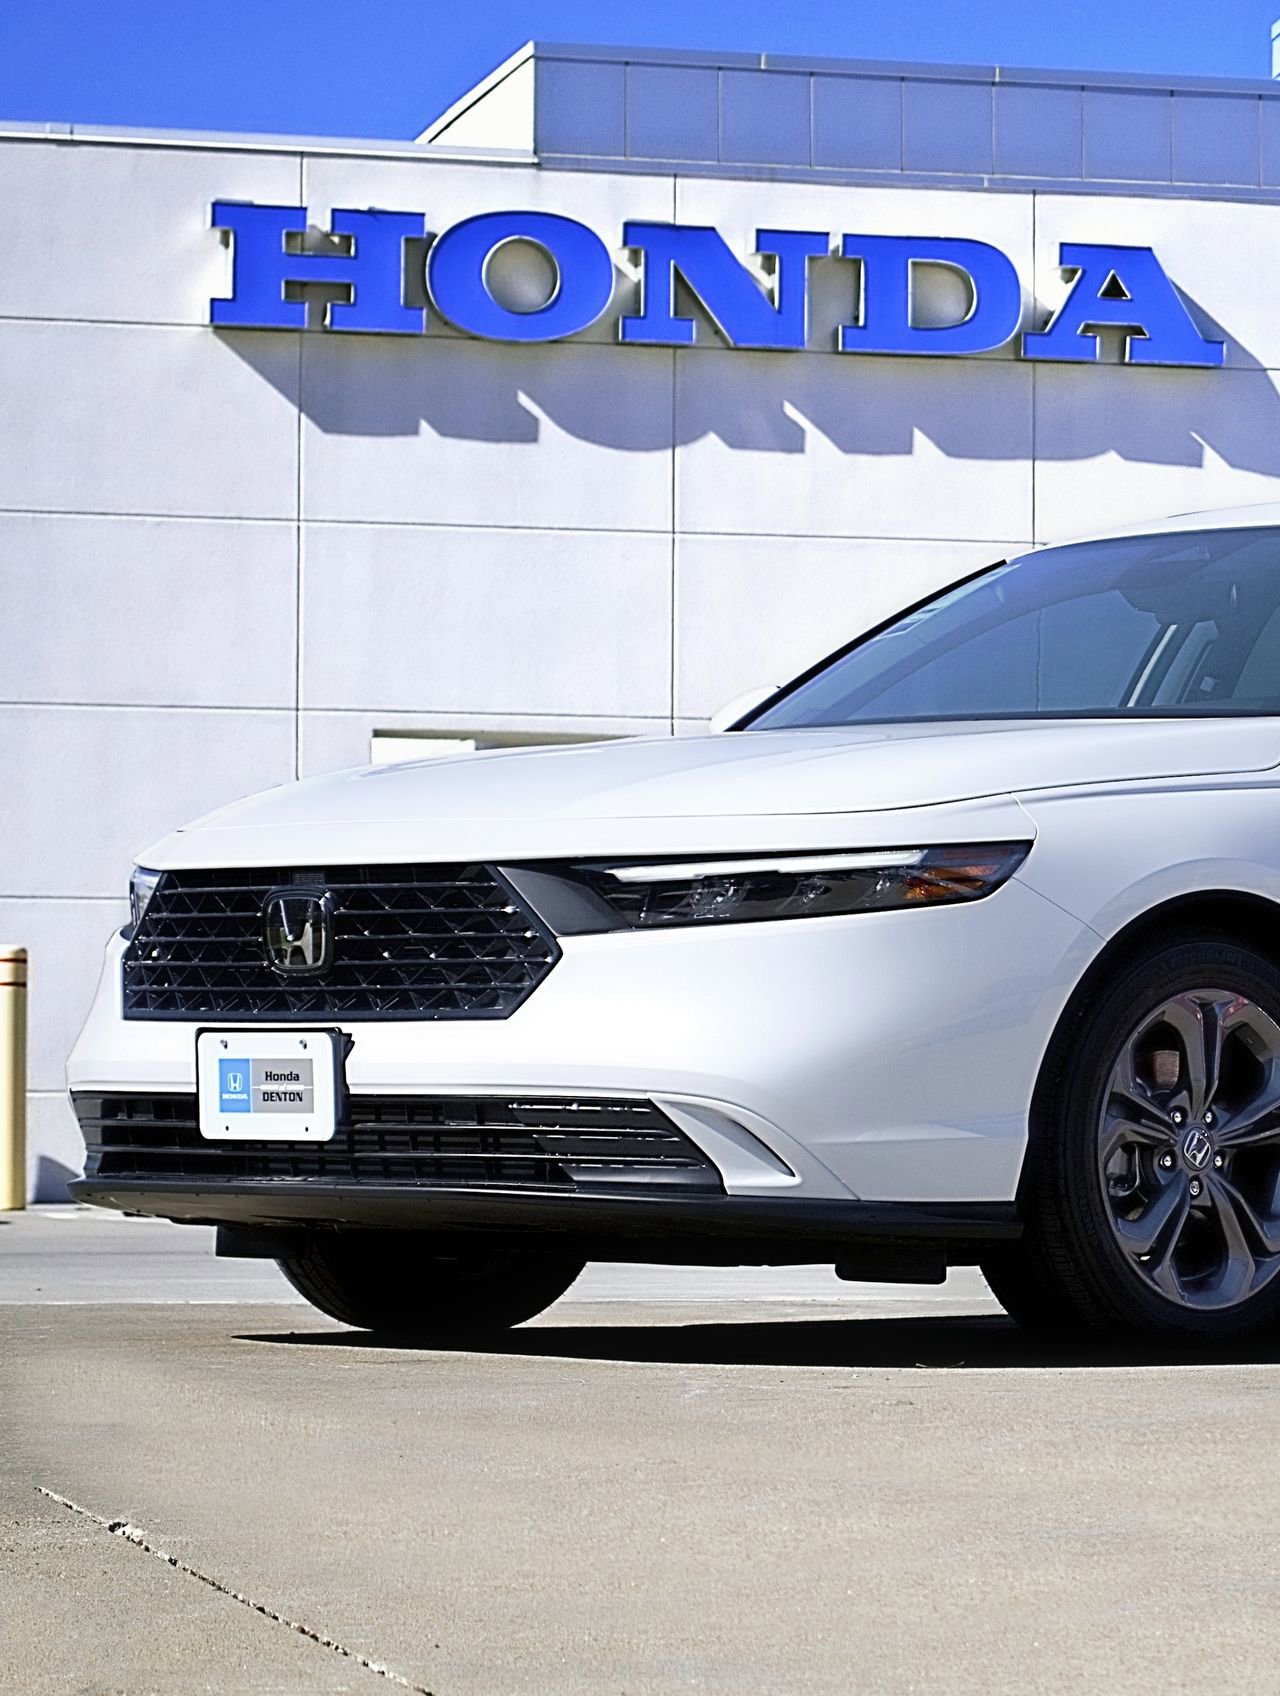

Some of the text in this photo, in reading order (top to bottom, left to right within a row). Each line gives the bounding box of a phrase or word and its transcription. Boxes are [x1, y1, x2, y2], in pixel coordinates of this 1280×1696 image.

[209, 200, 1225, 367] HONDA
[265, 1071, 300, 1082] Honda
[262, 1091, 303, 1102] DENTON
